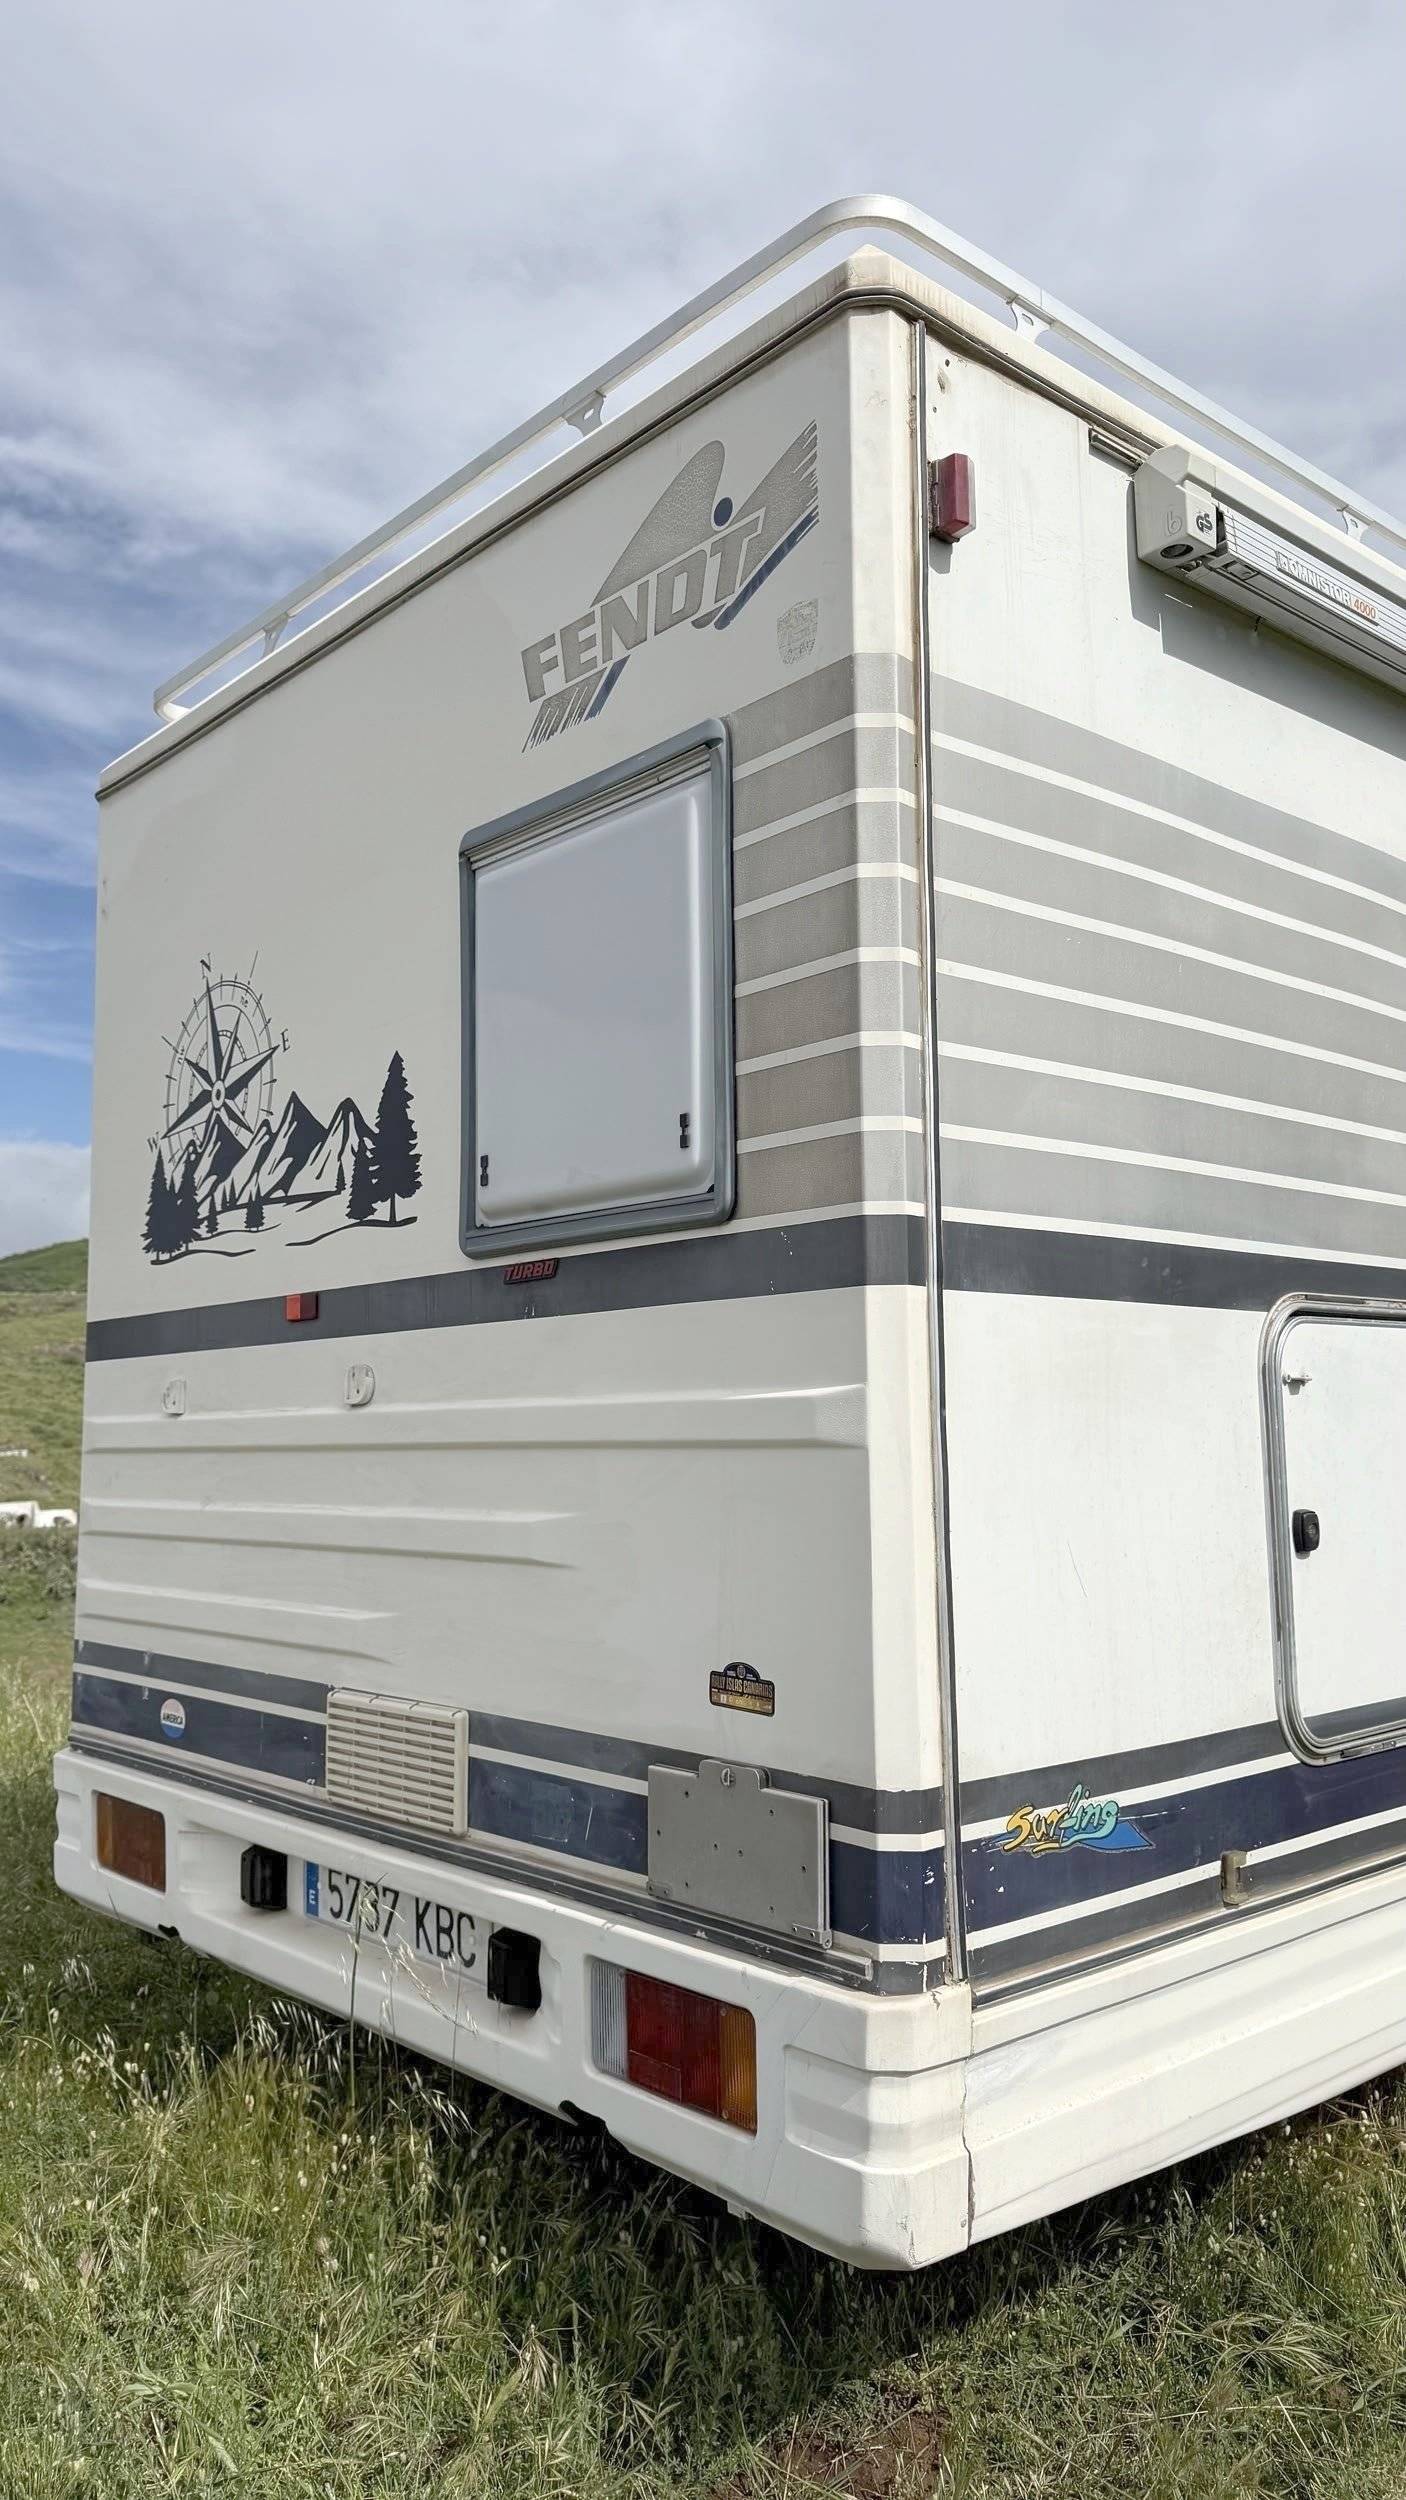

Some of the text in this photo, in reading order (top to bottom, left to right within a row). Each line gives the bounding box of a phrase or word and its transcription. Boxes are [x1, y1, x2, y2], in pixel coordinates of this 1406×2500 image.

[521, 517, 761, 702] FENDT
[1353, 598, 1377, 619] 4000
[200, 953, 211, 978] N
[281, 1029, 291, 1052] E
[504, 1260, 556, 1281] TURBO
[726, 1677, 742, 1692] ISLAS
[1002, 1784, 1119, 1854] Surfing
[308, 1889, 316, 1905] E
[415, 1896, 477, 1969] KBC
